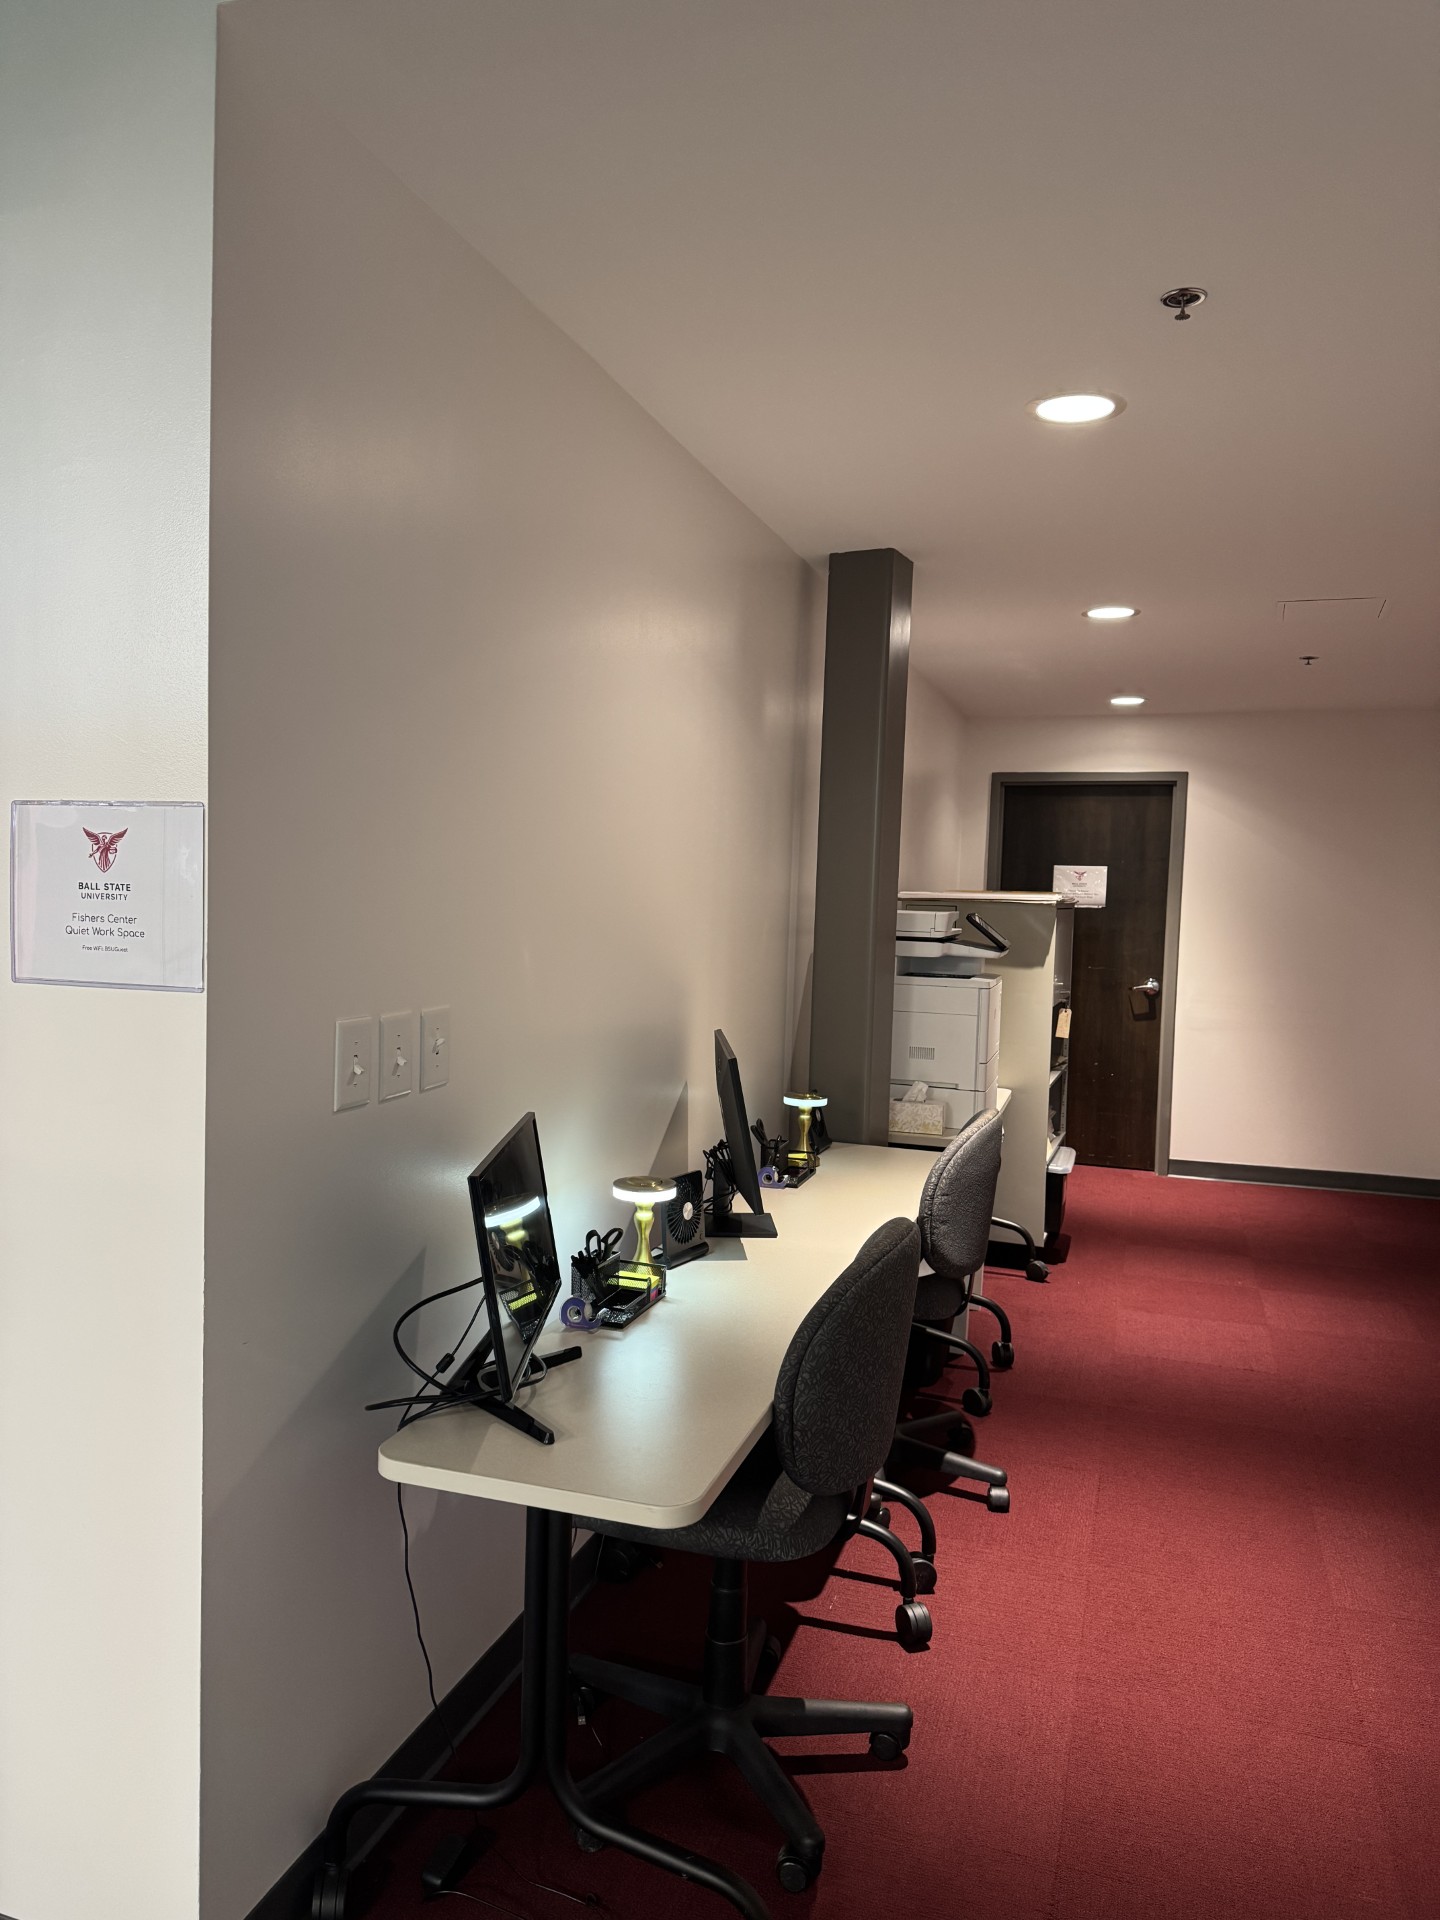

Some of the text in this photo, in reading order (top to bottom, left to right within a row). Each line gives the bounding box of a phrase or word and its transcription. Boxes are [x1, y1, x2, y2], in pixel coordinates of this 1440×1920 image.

[78, 881, 131, 892] BALL STATE
[80, 892, 128, 901] UNIVERSITY
[71, 912, 138, 925] Fishers Center
[65, 925, 145, 939] Quiet Work Space
